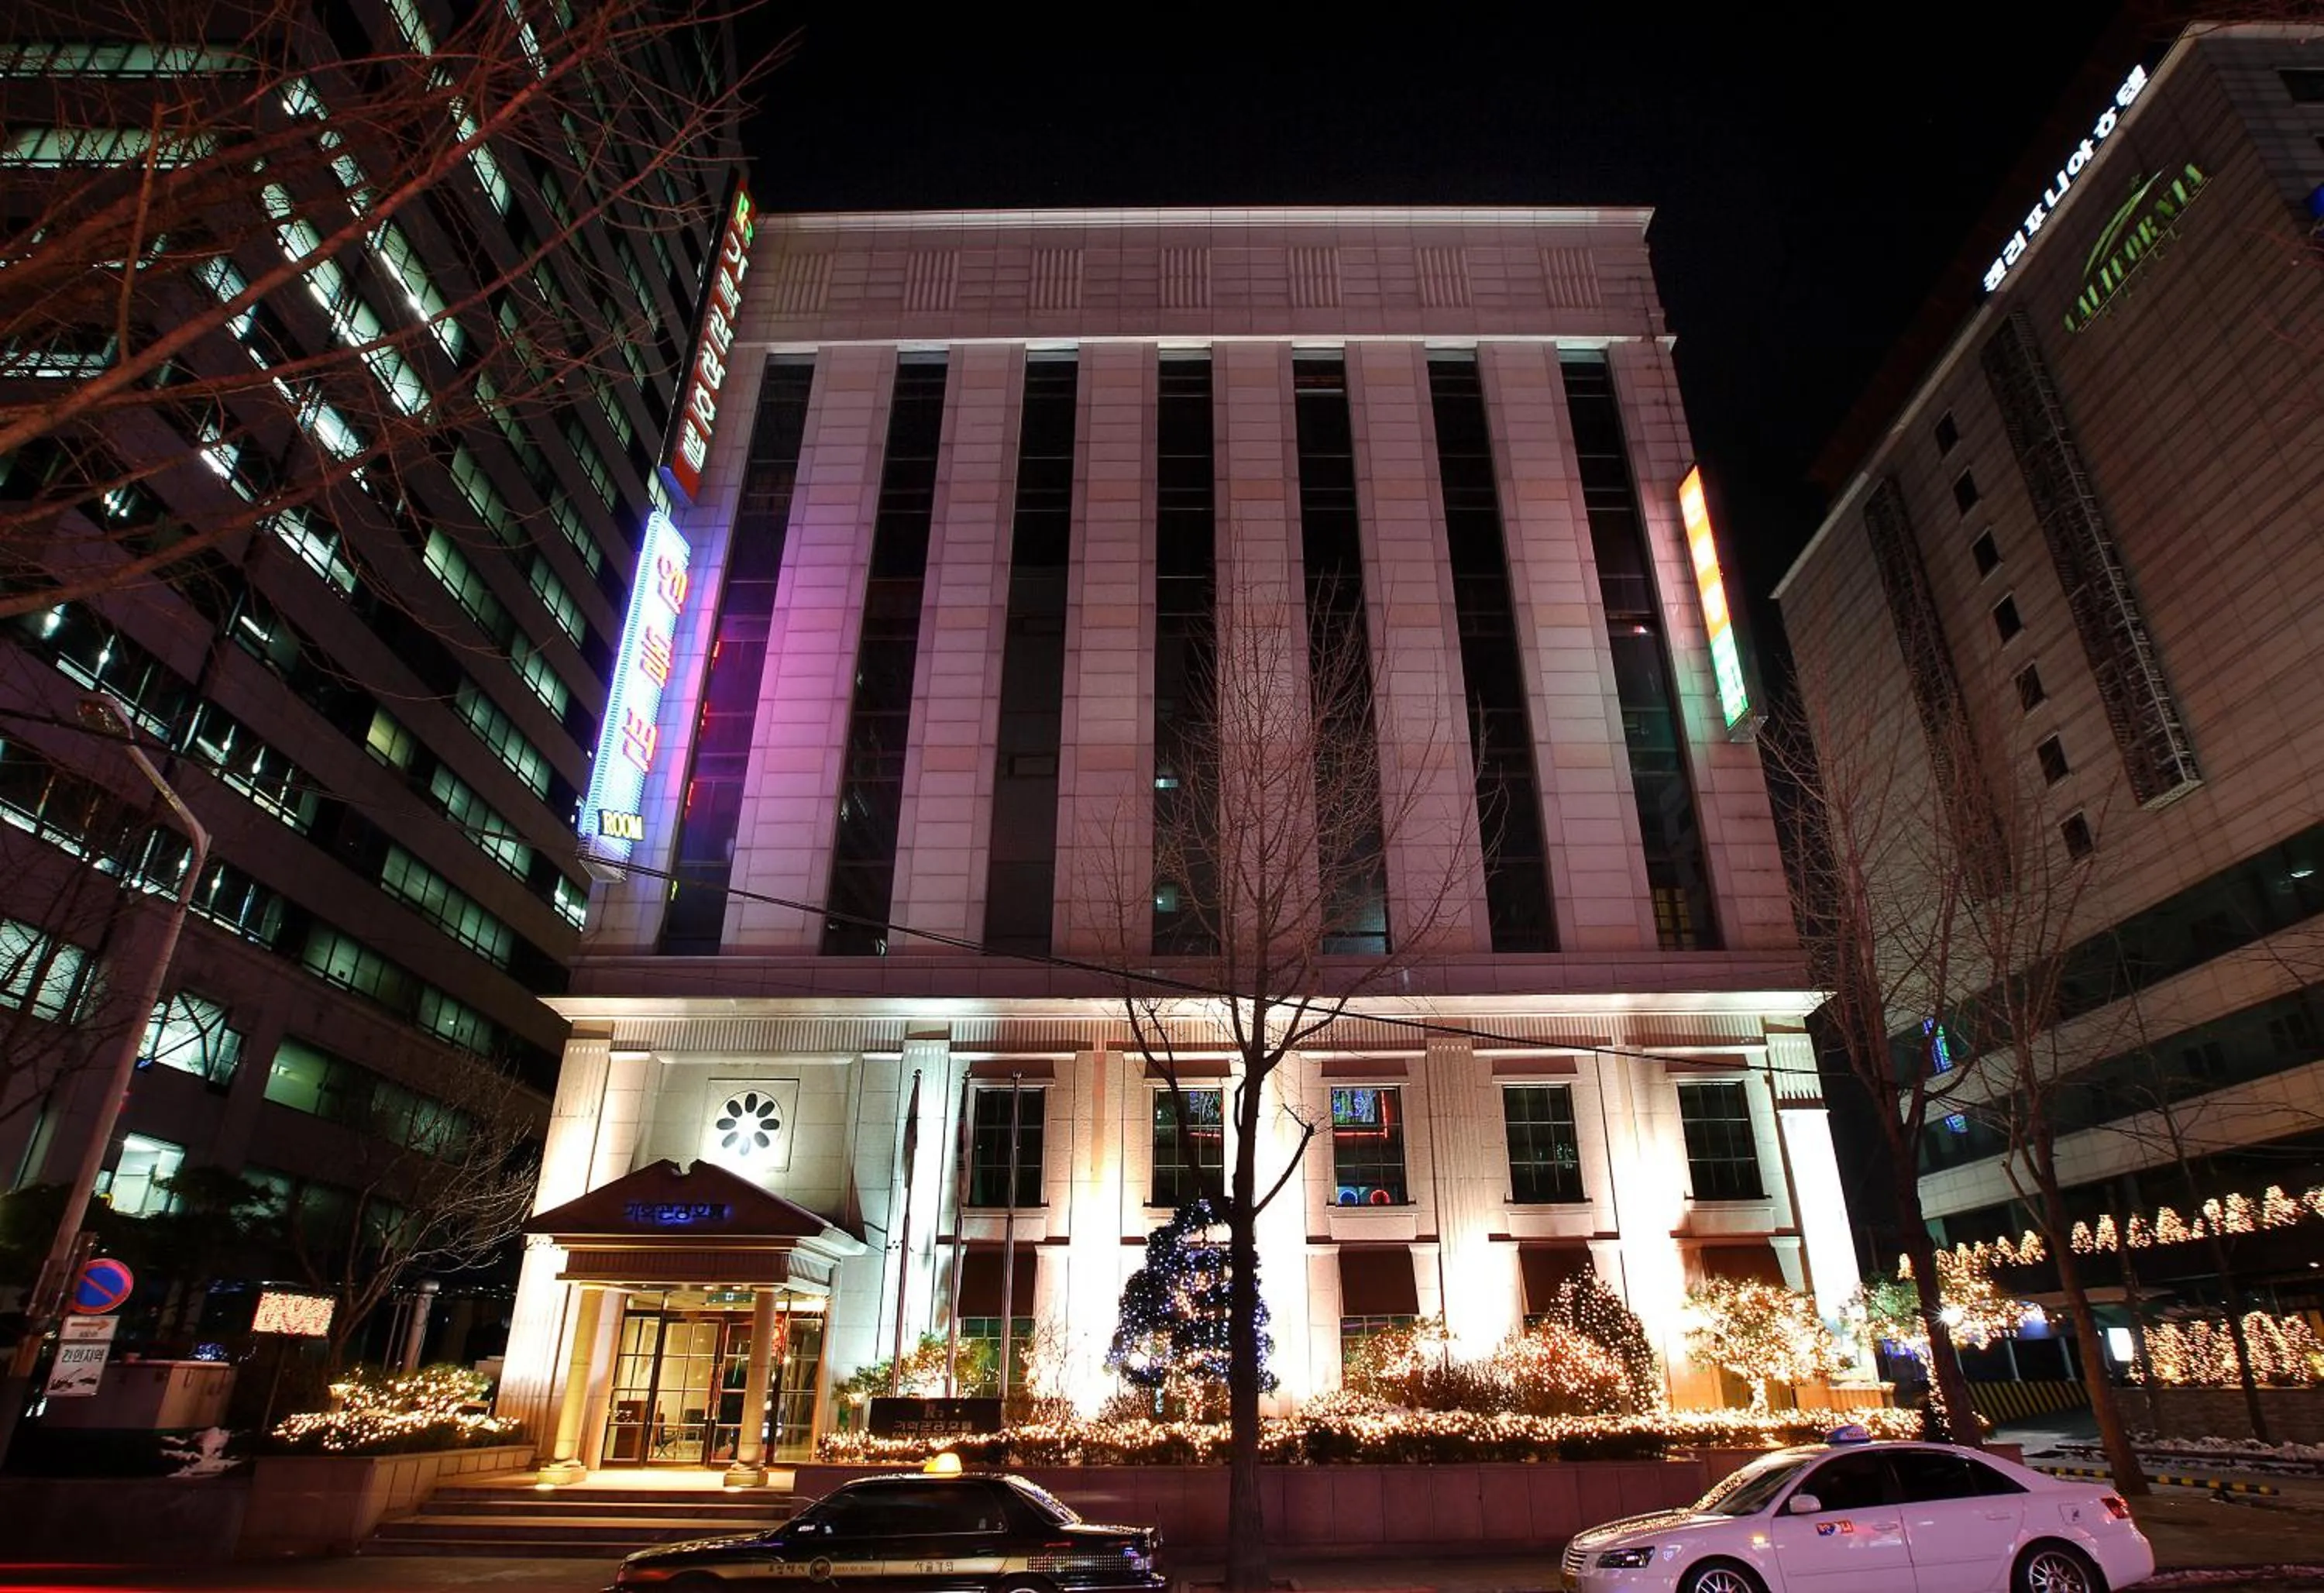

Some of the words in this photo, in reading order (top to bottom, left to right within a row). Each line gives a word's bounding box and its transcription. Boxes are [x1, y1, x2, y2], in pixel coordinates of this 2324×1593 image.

[1982, 64, 2149, 292] 캘리포니아호텔
[682, 230, 750, 473] 가락관광호텔
[602, 810, 644, 841] ROOM
[61, 1349, 105, 1363] 견인지역
